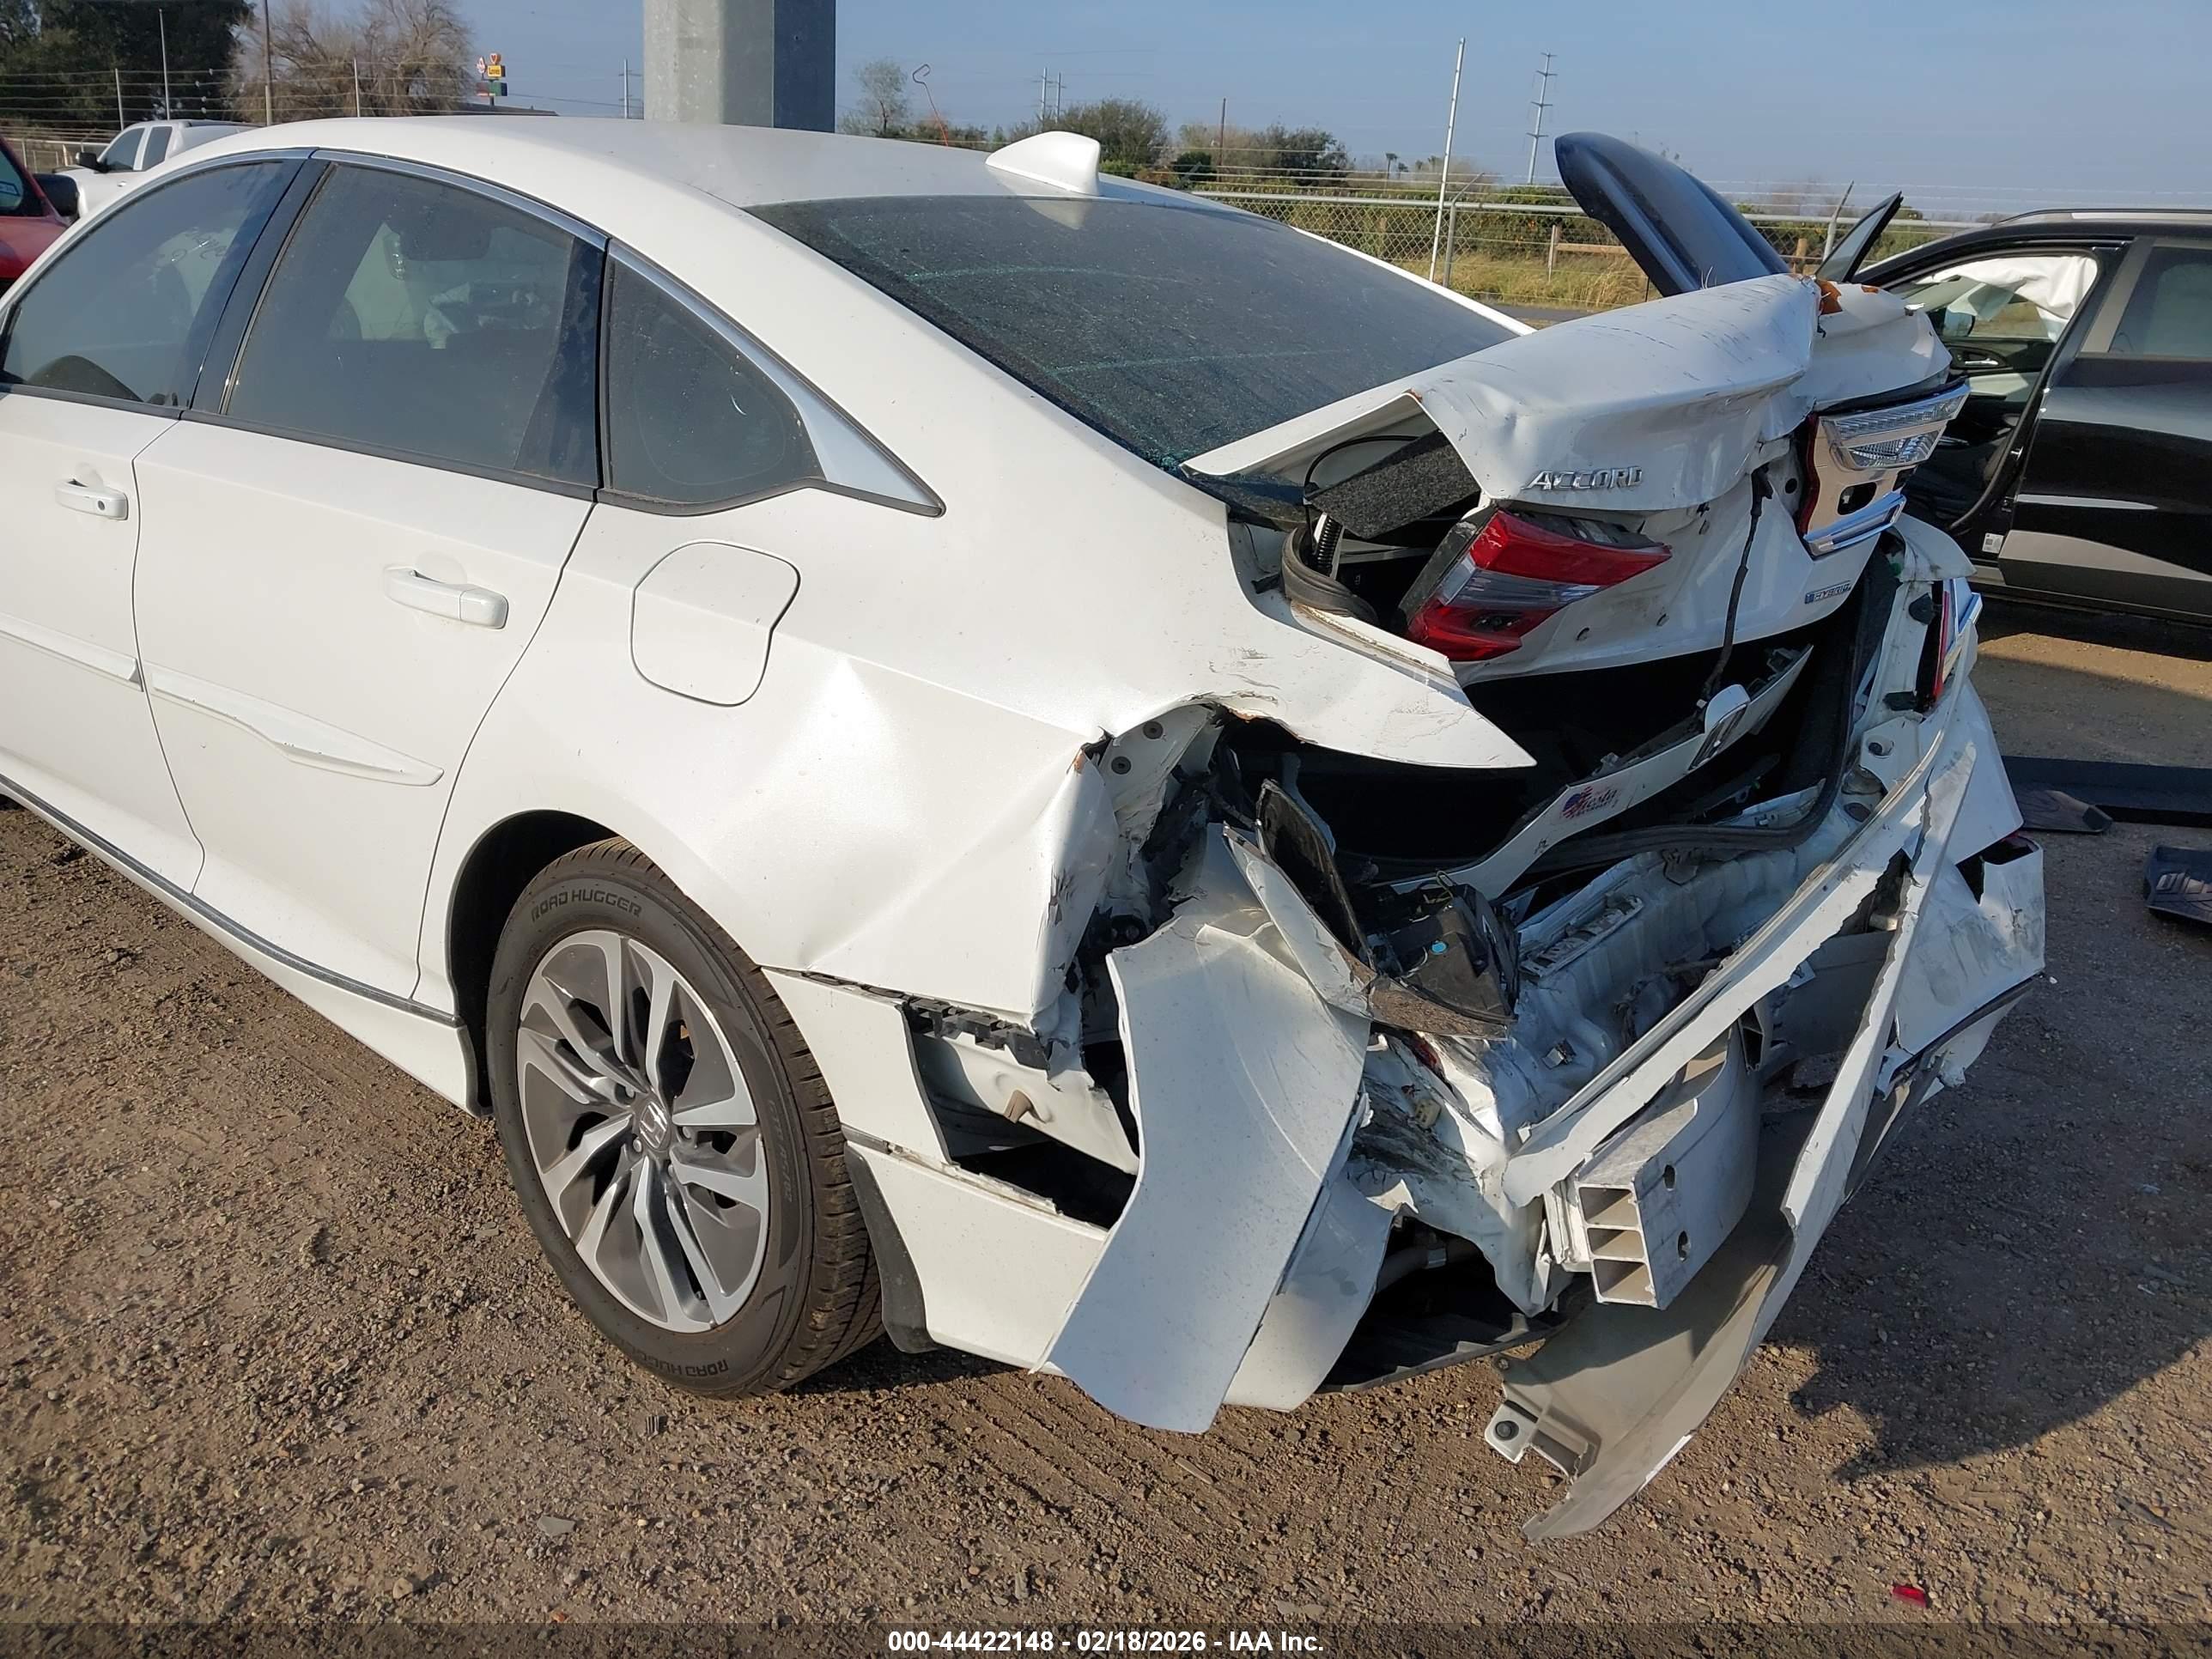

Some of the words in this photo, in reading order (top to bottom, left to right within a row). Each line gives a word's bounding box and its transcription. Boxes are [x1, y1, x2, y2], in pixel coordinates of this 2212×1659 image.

[1521, 465, 1643, 490] ACCORD
[531, 890, 568, 922] ROAD
[571, 889, 642, 918] HUGGER
[684, 1359, 729, 1377] ROAD
